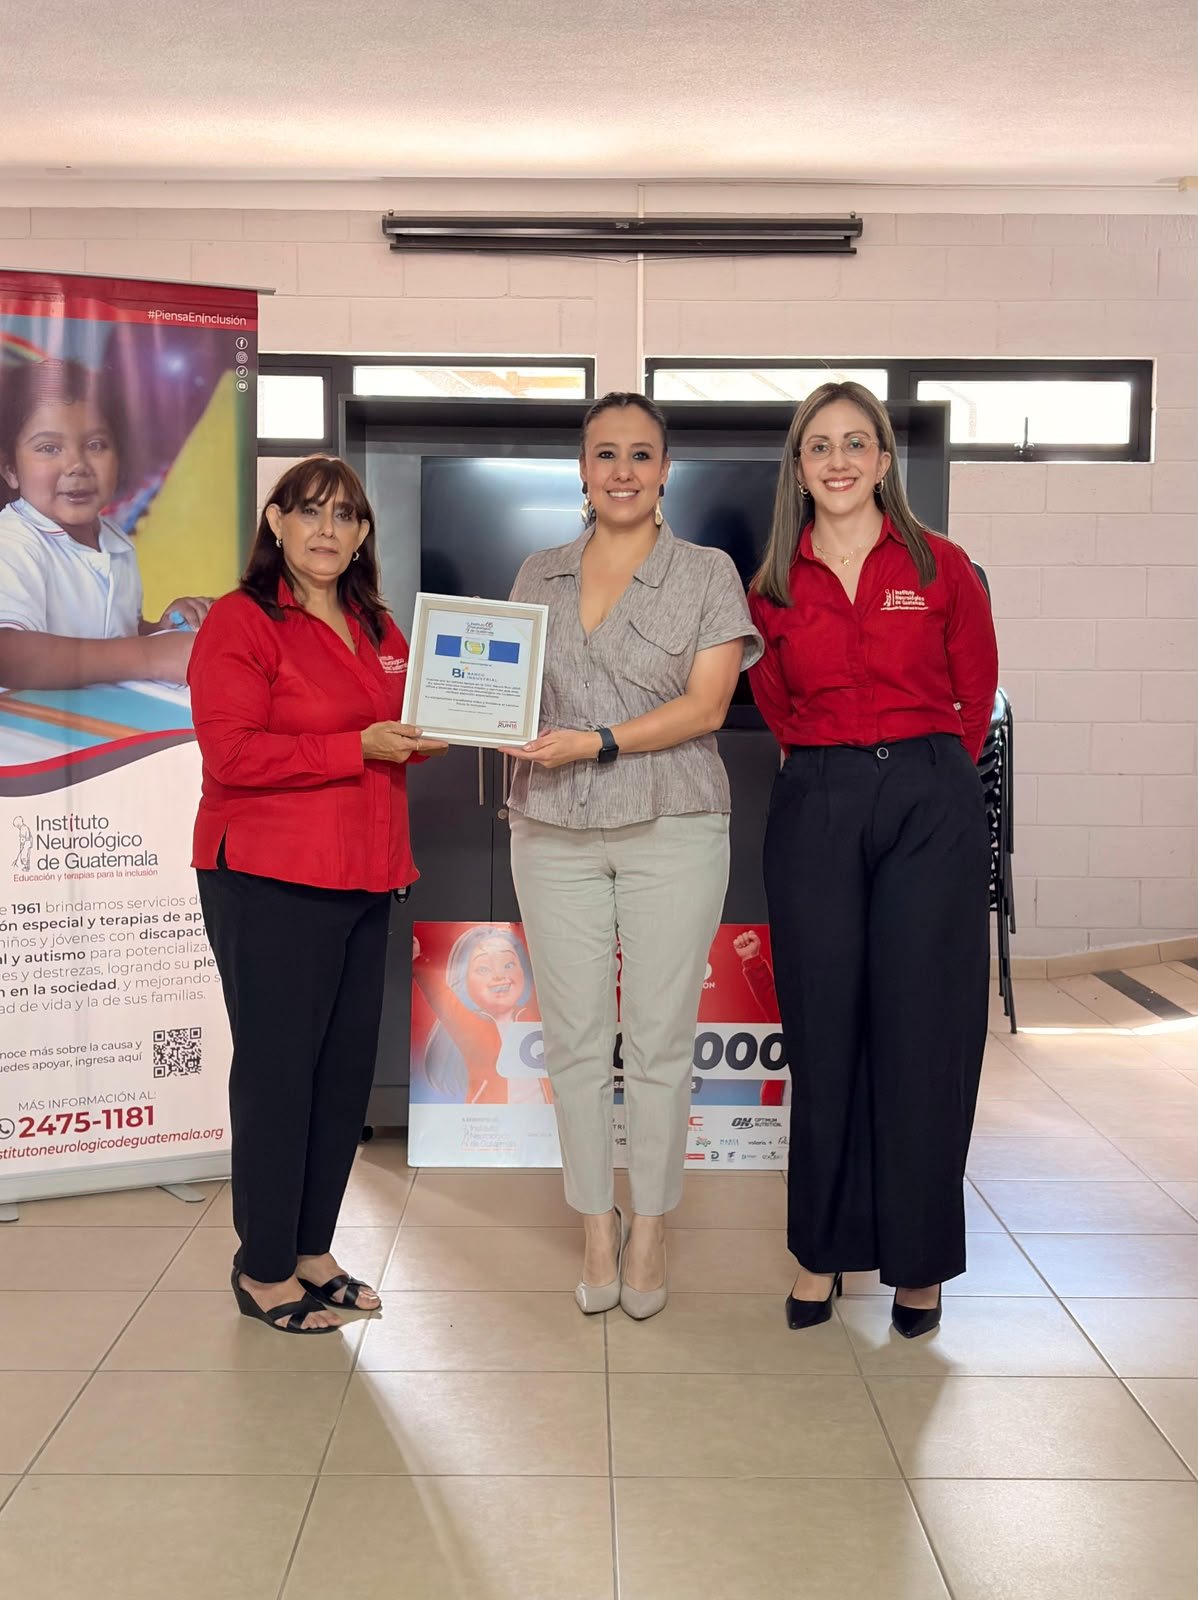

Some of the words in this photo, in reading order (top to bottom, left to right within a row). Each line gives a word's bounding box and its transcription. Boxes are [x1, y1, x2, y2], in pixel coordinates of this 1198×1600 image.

[147, 309, 247, 326] #PiensaEnInclusión
[36, 813, 109, 832] Instituto
[36, 831, 143, 852] Neurológico
[37, 854, 60, 871] de
[65, 850, 159, 869] Guatemala
[13, 873, 56, 882] Educación
[57, 874, 62, 882] y
[64, 871, 95, 881] terapias
[96, 872, 115, 880] para
[116, 870, 123, 878] la
[124, 868, 159, 877] inclusión
[11, 903, 41, 915] 1961
[46, 899, 124, 914] brindamos
[127, 896, 186, 909] servicios
[22, 916, 83, 933] especial
[87, 918, 96, 930] y
[100, 913, 159, 928] terapias
[162, 911, 181, 923] de
[40, 937, 49, 949] y
[50, 932, 106, 948] jóvenes
[109, 931, 135, 942] con
[11, 955, 20, 967] y
[24, 950, 86, 964] autismo
[90, 948, 121, 962] para
[21, 971, 30, 983] y
[33, 964, 104, 980] destrezas,
[107, 957, 171, 976] logrando
[174, 960, 190, 970] su
[10, 987, 29, 997] en
[33, 984, 46, 996] la
[50, 979, 120, 995] sociedad,
[122, 980, 132, 992] y
[135, 972, 210, 990] mejorando
[19, 1000, 39, 1013] de
[41, 998, 72, 1012] vida
[74, 1001, 84, 1013] y
[87, 996, 98, 1008] la
[102, 994, 121, 1007] de
[124, 994, 148, 1005] sus
[150, 990, 206, 1004] familias.
[29, 1046, 54, 1057] más
[56, 1044, 87, 1056] sobre
[89, 1042, 99, 1052] la
[101, 1042, 133, 1051] causa
[135, 1041, 143, 1050] y
[32, 1059, 73, 1072] apoyar,
[75, 1054, 115, 1068] ingresa
[118, 1052, 143, 1065] aquí
[18, 1098, 45, 1112] MÁS
[48, 1092, 136, 1110] INFORMACIÓN
[138, 1090, 157, 1100] AL:
[18, 1105, 155, 1139] 2475-1181
